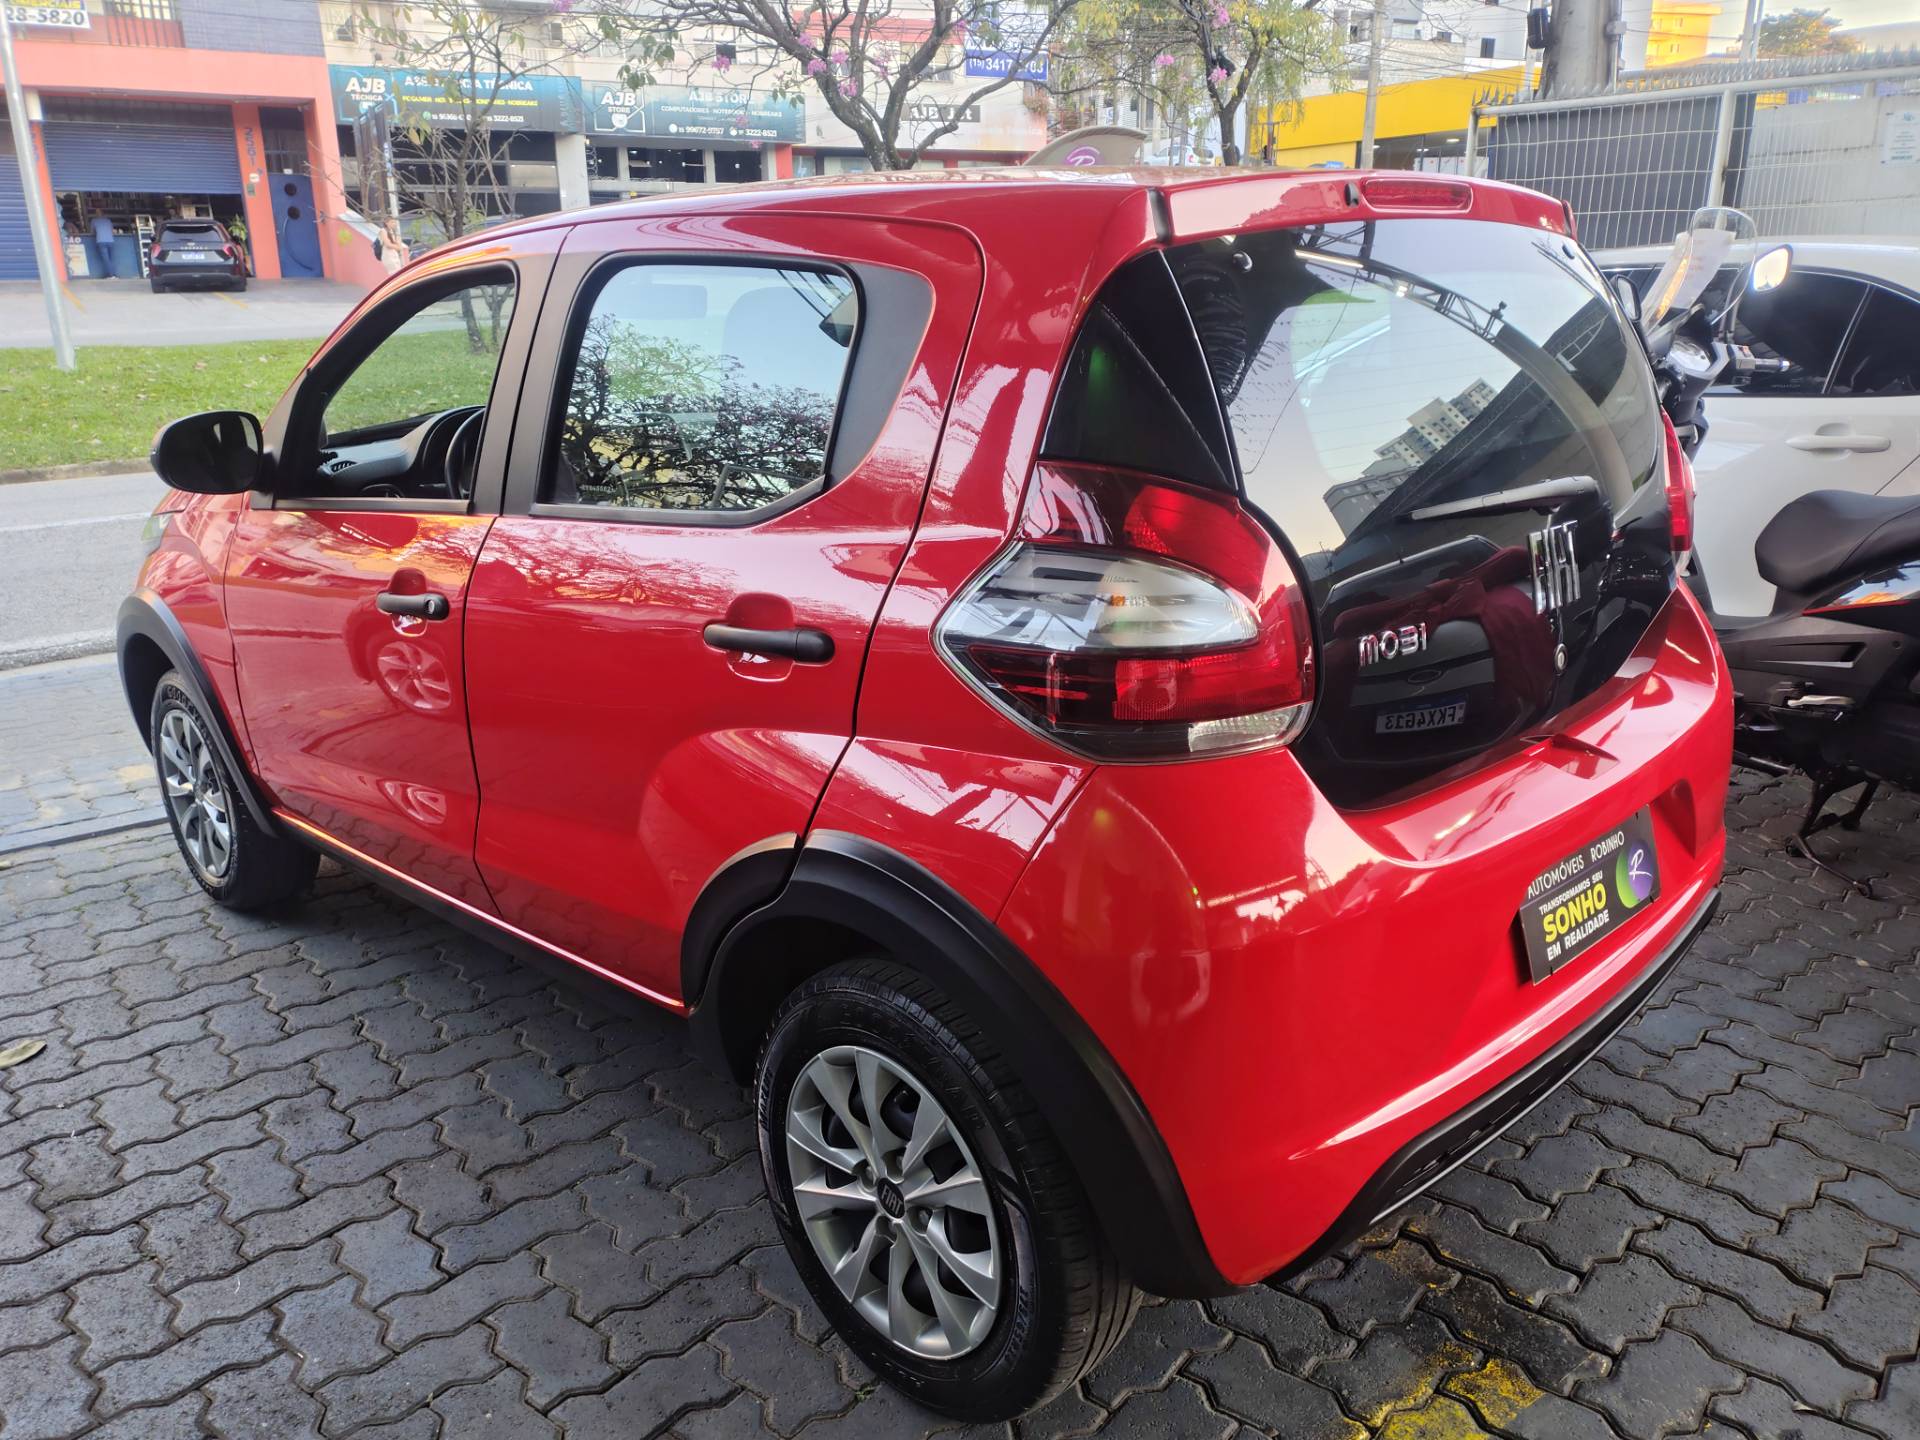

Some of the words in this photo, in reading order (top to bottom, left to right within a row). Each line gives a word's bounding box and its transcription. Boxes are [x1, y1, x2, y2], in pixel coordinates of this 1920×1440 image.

[345, 77, 386, 93] AJB
[601, 91, 636, 106] AJB
[1359, 622, 1427, 667] MOBI
[1527, 854, 1585, 899] AUTOMÓVEIS
[1590, 831, 1625, 863] ROBINHO
[1538, 878, 1591, 915] TRANSFORMAMOS
[1543, 883, 1607, 943] SONHO
[1546, 944, 1562, 961] EM
[1564, 909, 1610, 950] REALIDADE
[881, 1184, 904, 1215] FIAT
